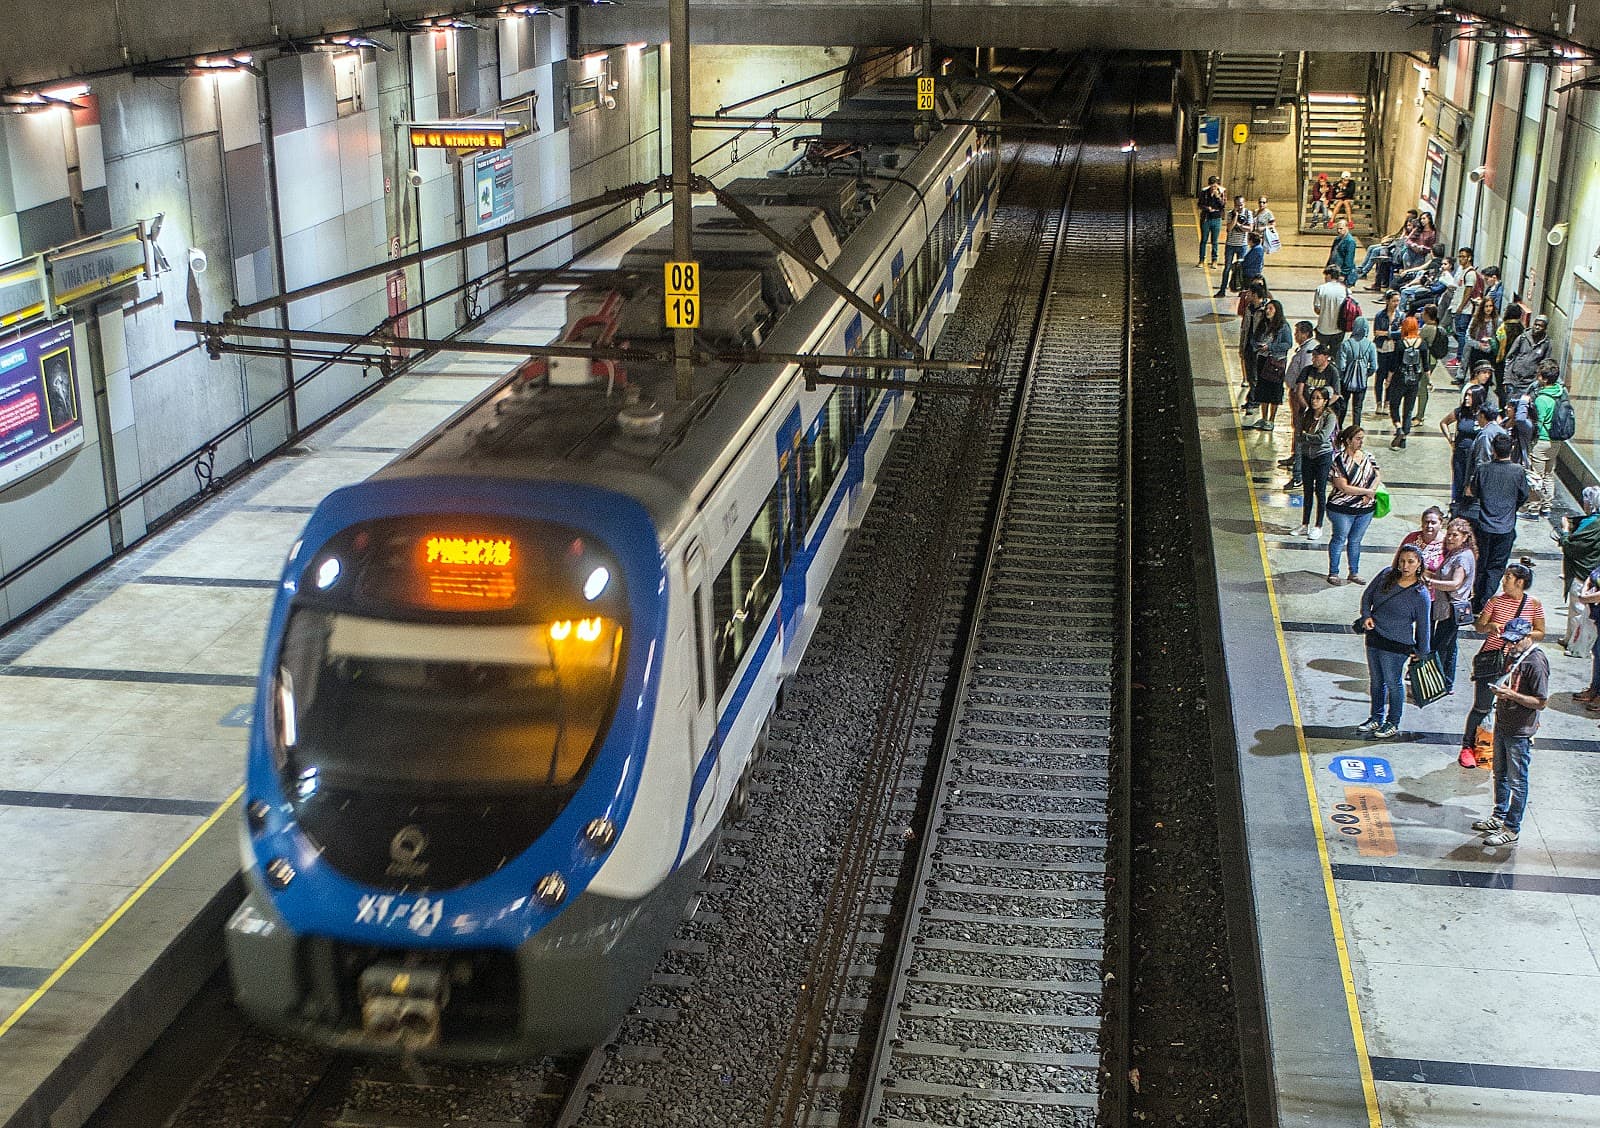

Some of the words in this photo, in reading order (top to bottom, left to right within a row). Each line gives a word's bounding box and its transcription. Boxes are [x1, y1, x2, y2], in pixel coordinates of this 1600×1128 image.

[920, 78, 932, 92] 08
[920, 95, 932, 108] 20
[82, 262, 97, 284] DEL
[672, 264, 694, 291] 08
[673, 298, 694, 325] 19
